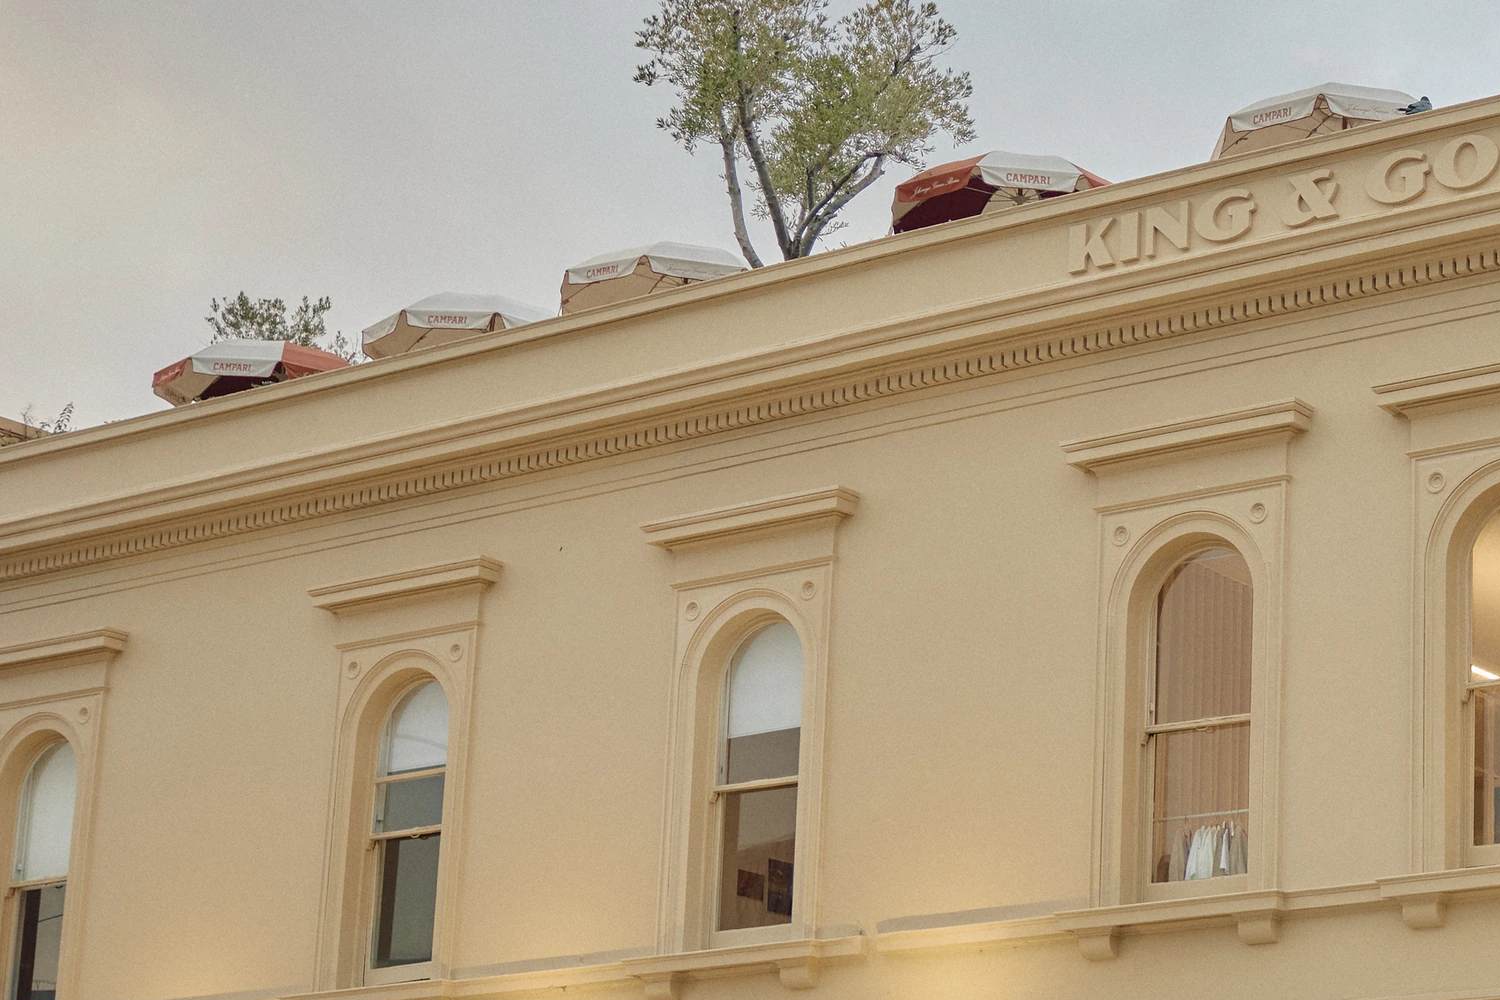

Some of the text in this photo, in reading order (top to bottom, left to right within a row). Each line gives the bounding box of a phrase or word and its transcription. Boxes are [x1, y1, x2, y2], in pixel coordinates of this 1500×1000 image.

[1252, 107, 1292, 125] CAMPARI
[1005, 172, 1052, 185] CAMPARI
[1068, 189, 1255, 276] KING
[1281, 168, 1340, 228] &
[585, 264, 619, 280] CAMPARI
[427, 314, 468, 326] CAMPARI
[212, 362, 252, 373] CAMPARI
